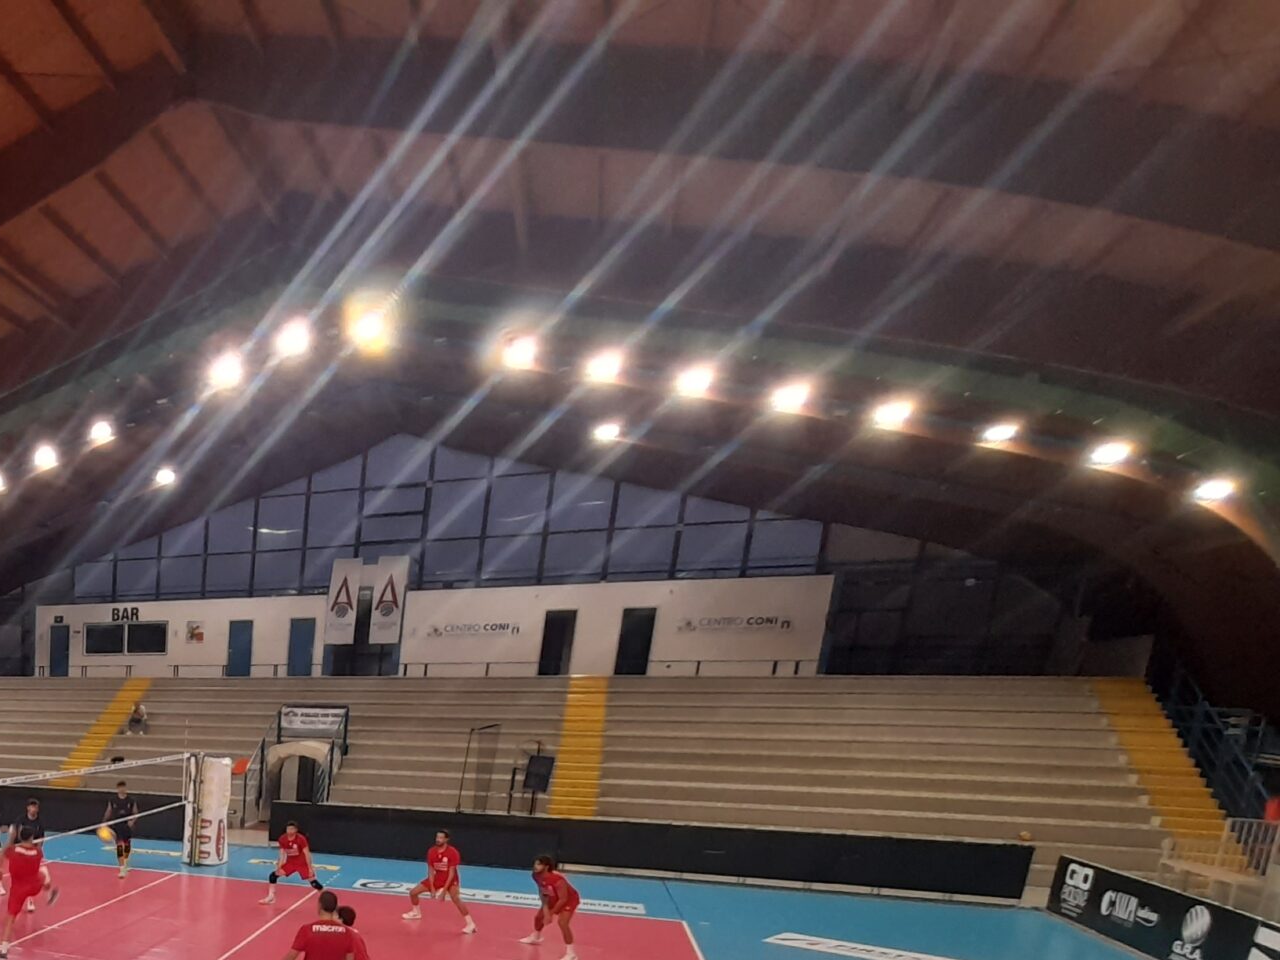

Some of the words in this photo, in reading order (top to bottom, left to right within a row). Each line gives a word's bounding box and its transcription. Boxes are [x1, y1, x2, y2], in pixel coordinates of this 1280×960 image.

[112, 607, 139, 621] BAR
[746, 616, 779, 626] CONI
[483, 623, 510, 631] CONI
